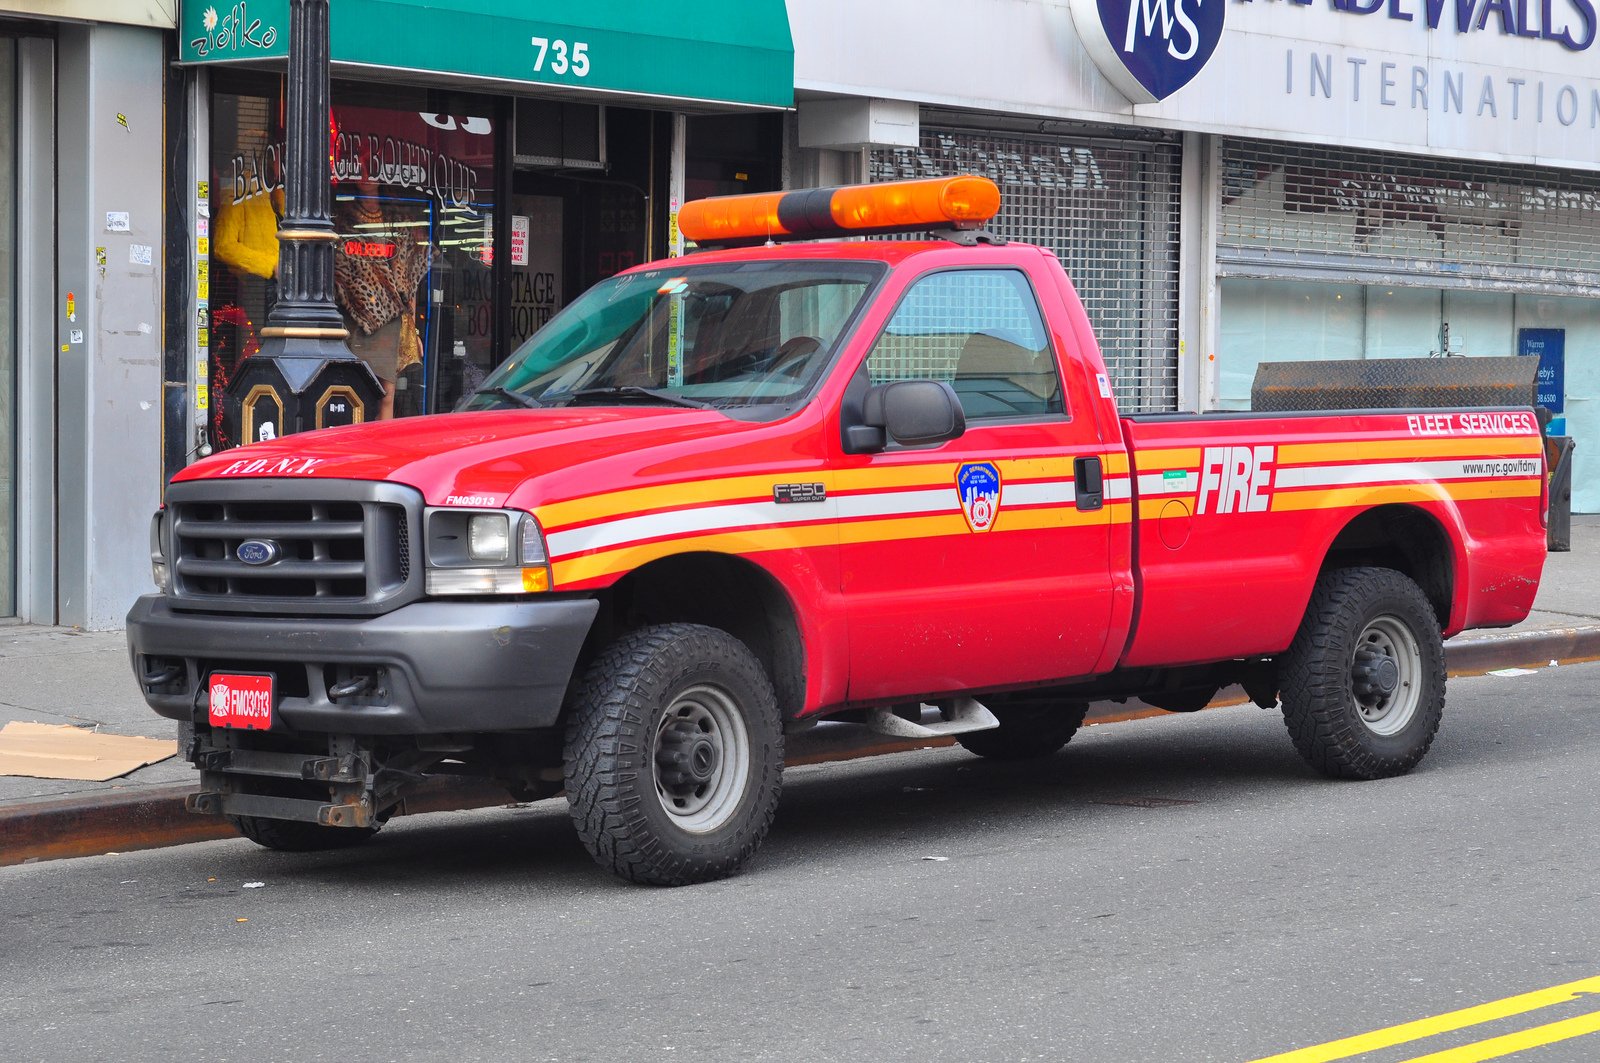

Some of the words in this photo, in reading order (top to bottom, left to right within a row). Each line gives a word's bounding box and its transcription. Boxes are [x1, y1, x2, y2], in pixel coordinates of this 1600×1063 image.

[531, 36, 590, 77] 735
[367, 134, 478, 216] BOUTIQUE
[1406, 415, 1453, 436] FLEET
[1459, 414, 1532, 435] SERVICES
[221, 458, 324, 475] F.D.N.Y.
[1462, 461, 1537, 477] www.nyc.gov/fdny
[1196, 445, 1275, 515] FIRE
[445, 495, 495, 506] FM03013
[243, 545, 264, 559] Ford
[231, 689, 269, 718] FM03013
